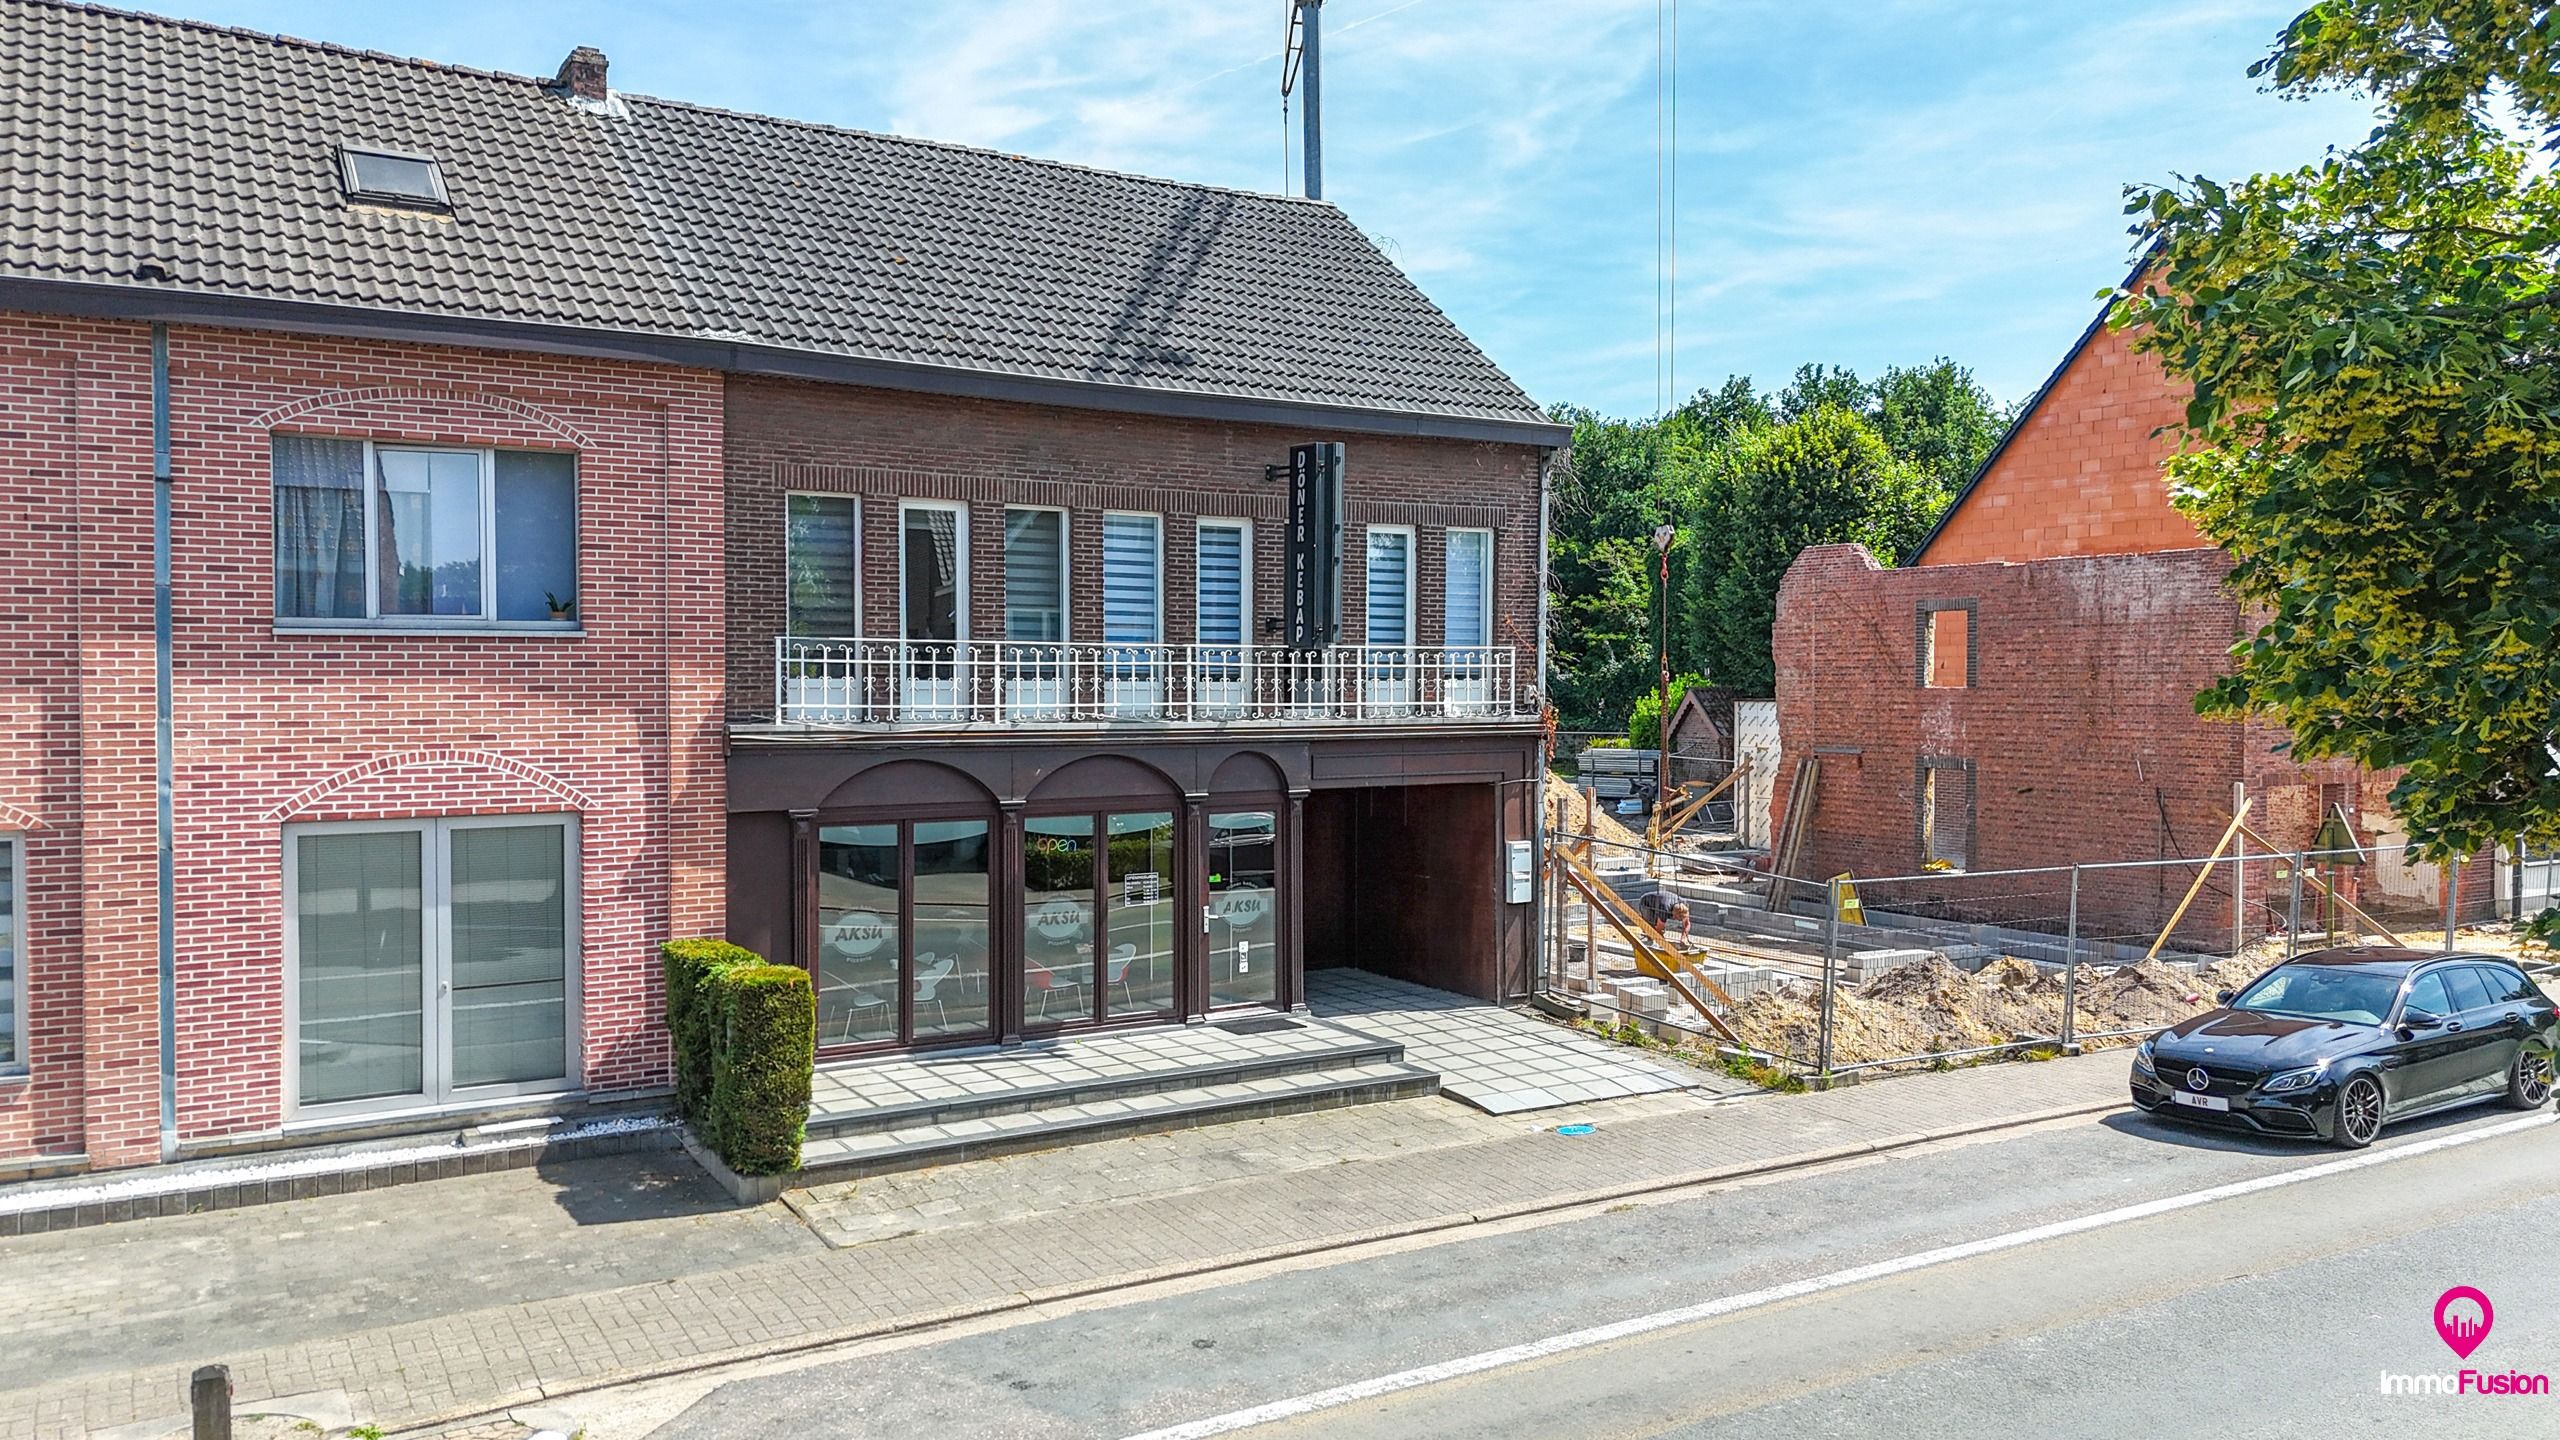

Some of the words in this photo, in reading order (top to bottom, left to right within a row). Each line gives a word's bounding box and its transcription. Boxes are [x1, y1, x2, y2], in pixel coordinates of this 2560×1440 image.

[1296, 451, 1305, 542] DÖNER
[1296, 553, 1304, 643] KEBAP
[1037, 838, 1077, 855] open
[2192, 1096, 2208, 1106] AVR
